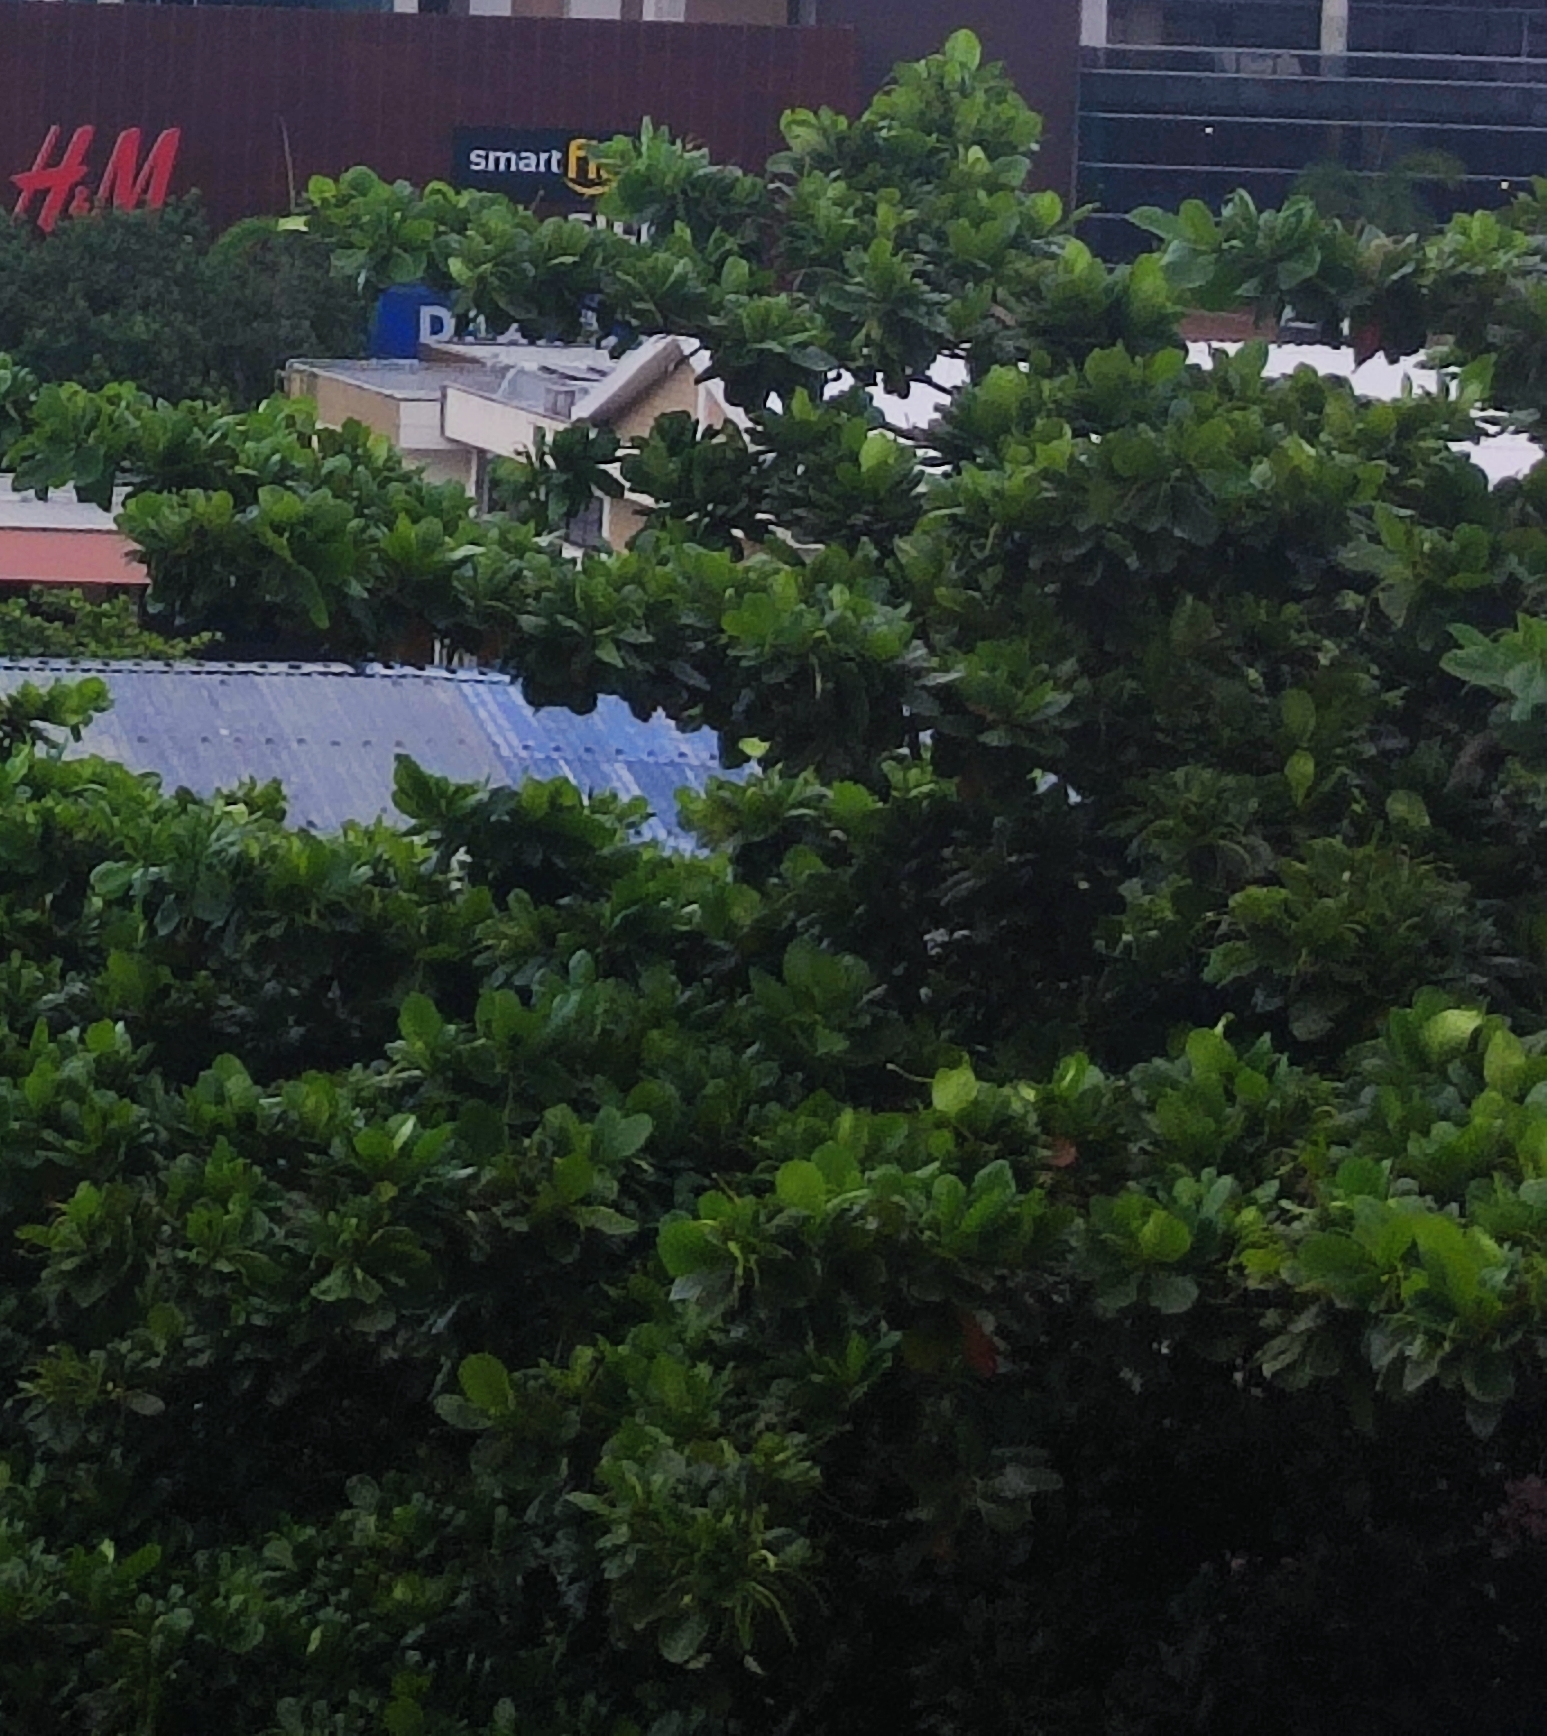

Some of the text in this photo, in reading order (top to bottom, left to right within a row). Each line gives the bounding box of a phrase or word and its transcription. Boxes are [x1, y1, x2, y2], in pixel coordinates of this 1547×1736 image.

[9, 125, 181, 232] H&M
[469, 138, 617, 182] smart fi
